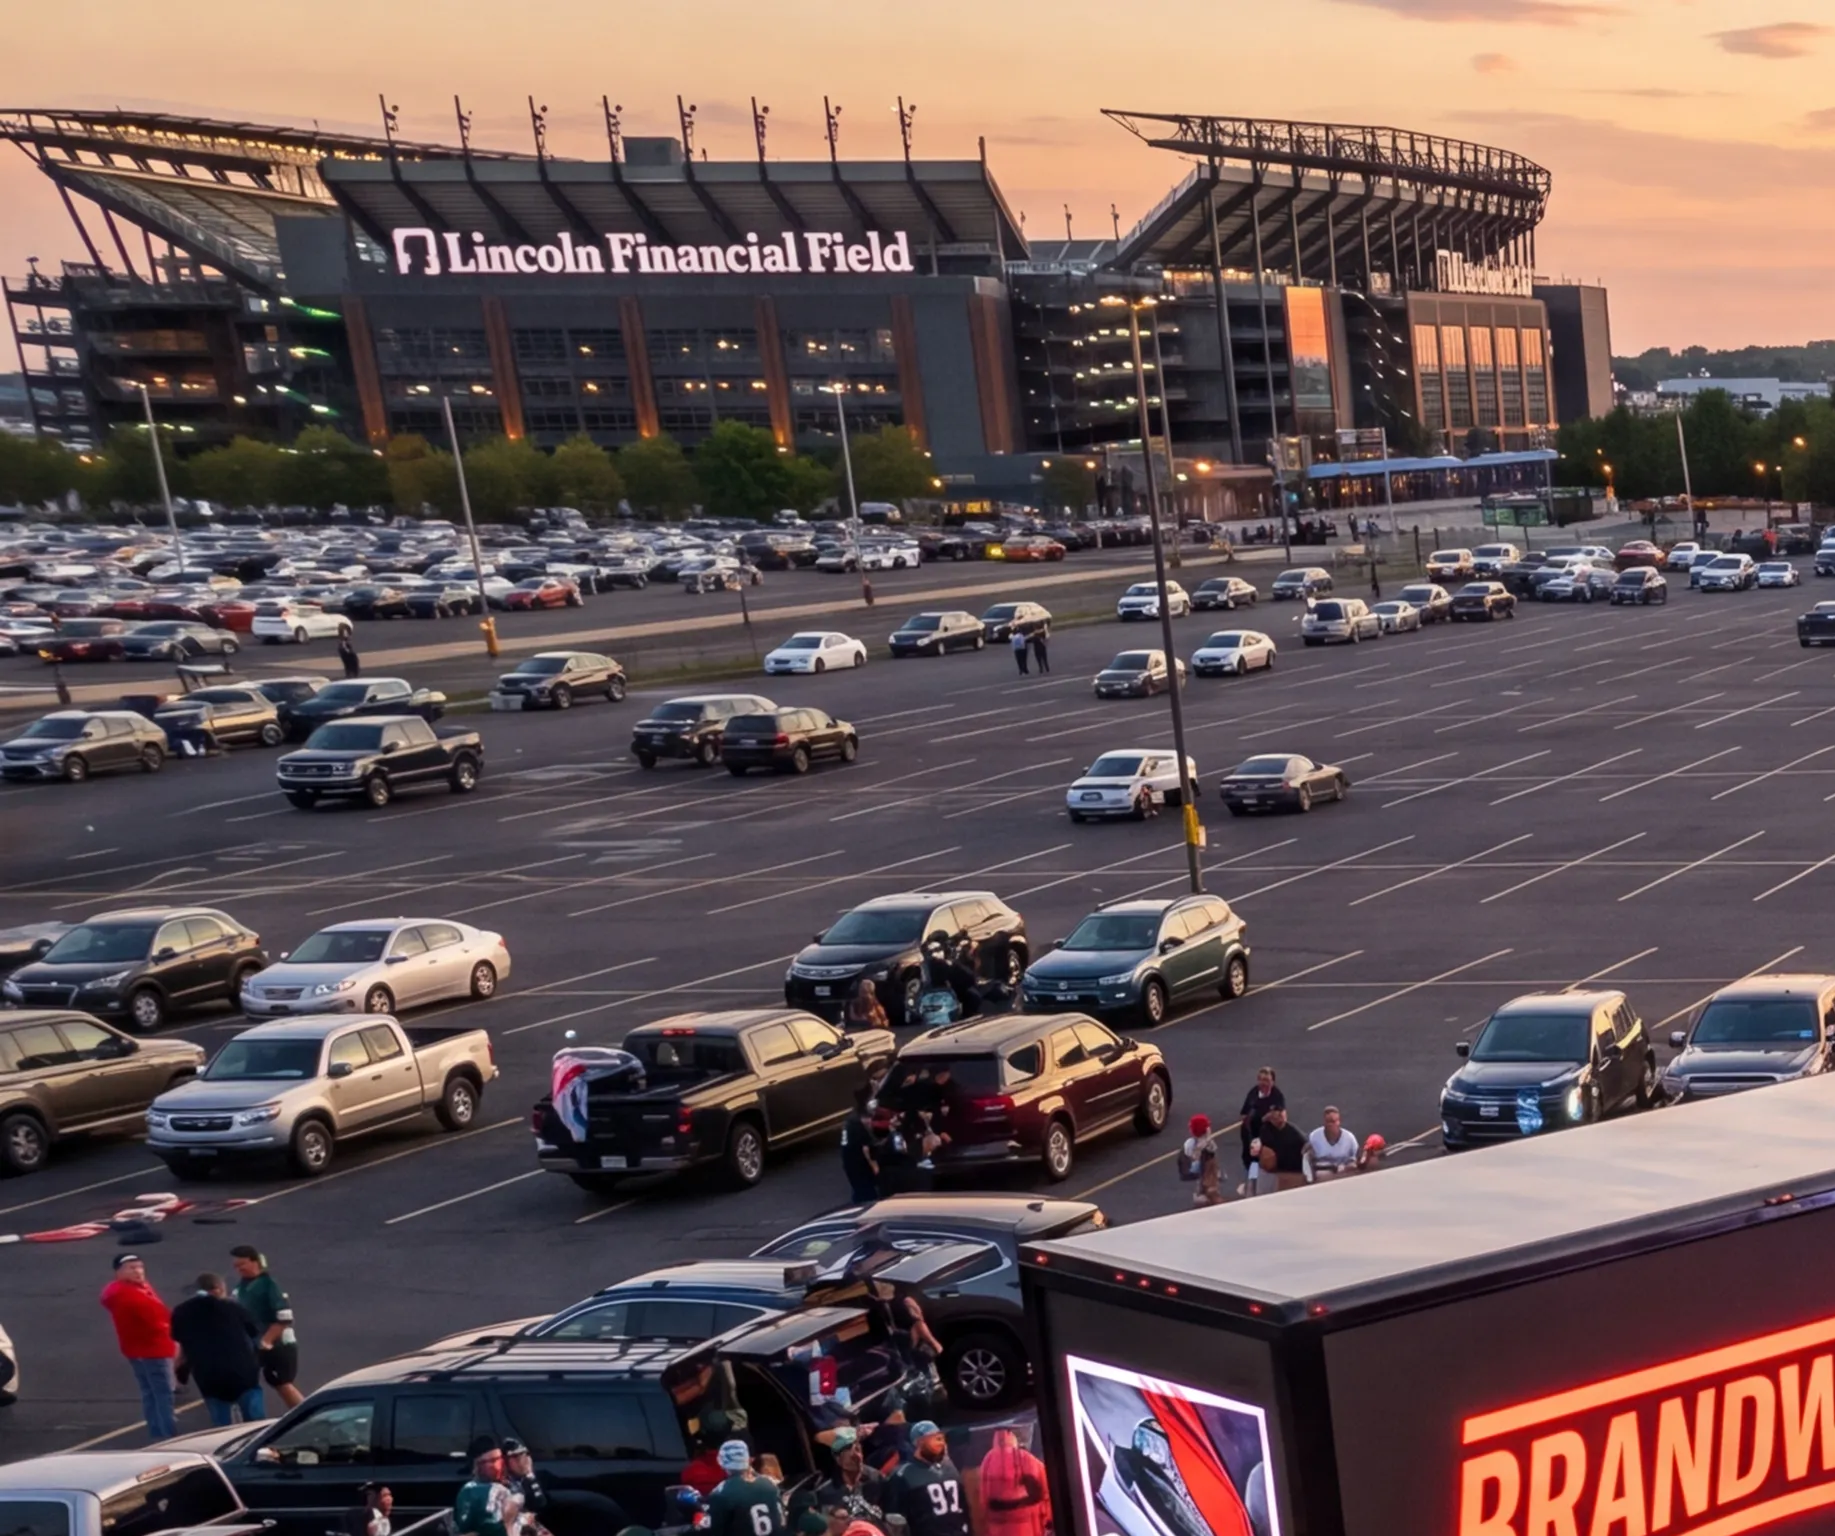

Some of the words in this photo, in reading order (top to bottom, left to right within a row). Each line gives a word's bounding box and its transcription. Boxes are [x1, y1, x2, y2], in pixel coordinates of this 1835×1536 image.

[443, 231, 604, 274] Lincoln
[605, 231, 801, 274] Financial
[804, 230, 915, 273] Field
[751, 1503, 773, 1536] 6
